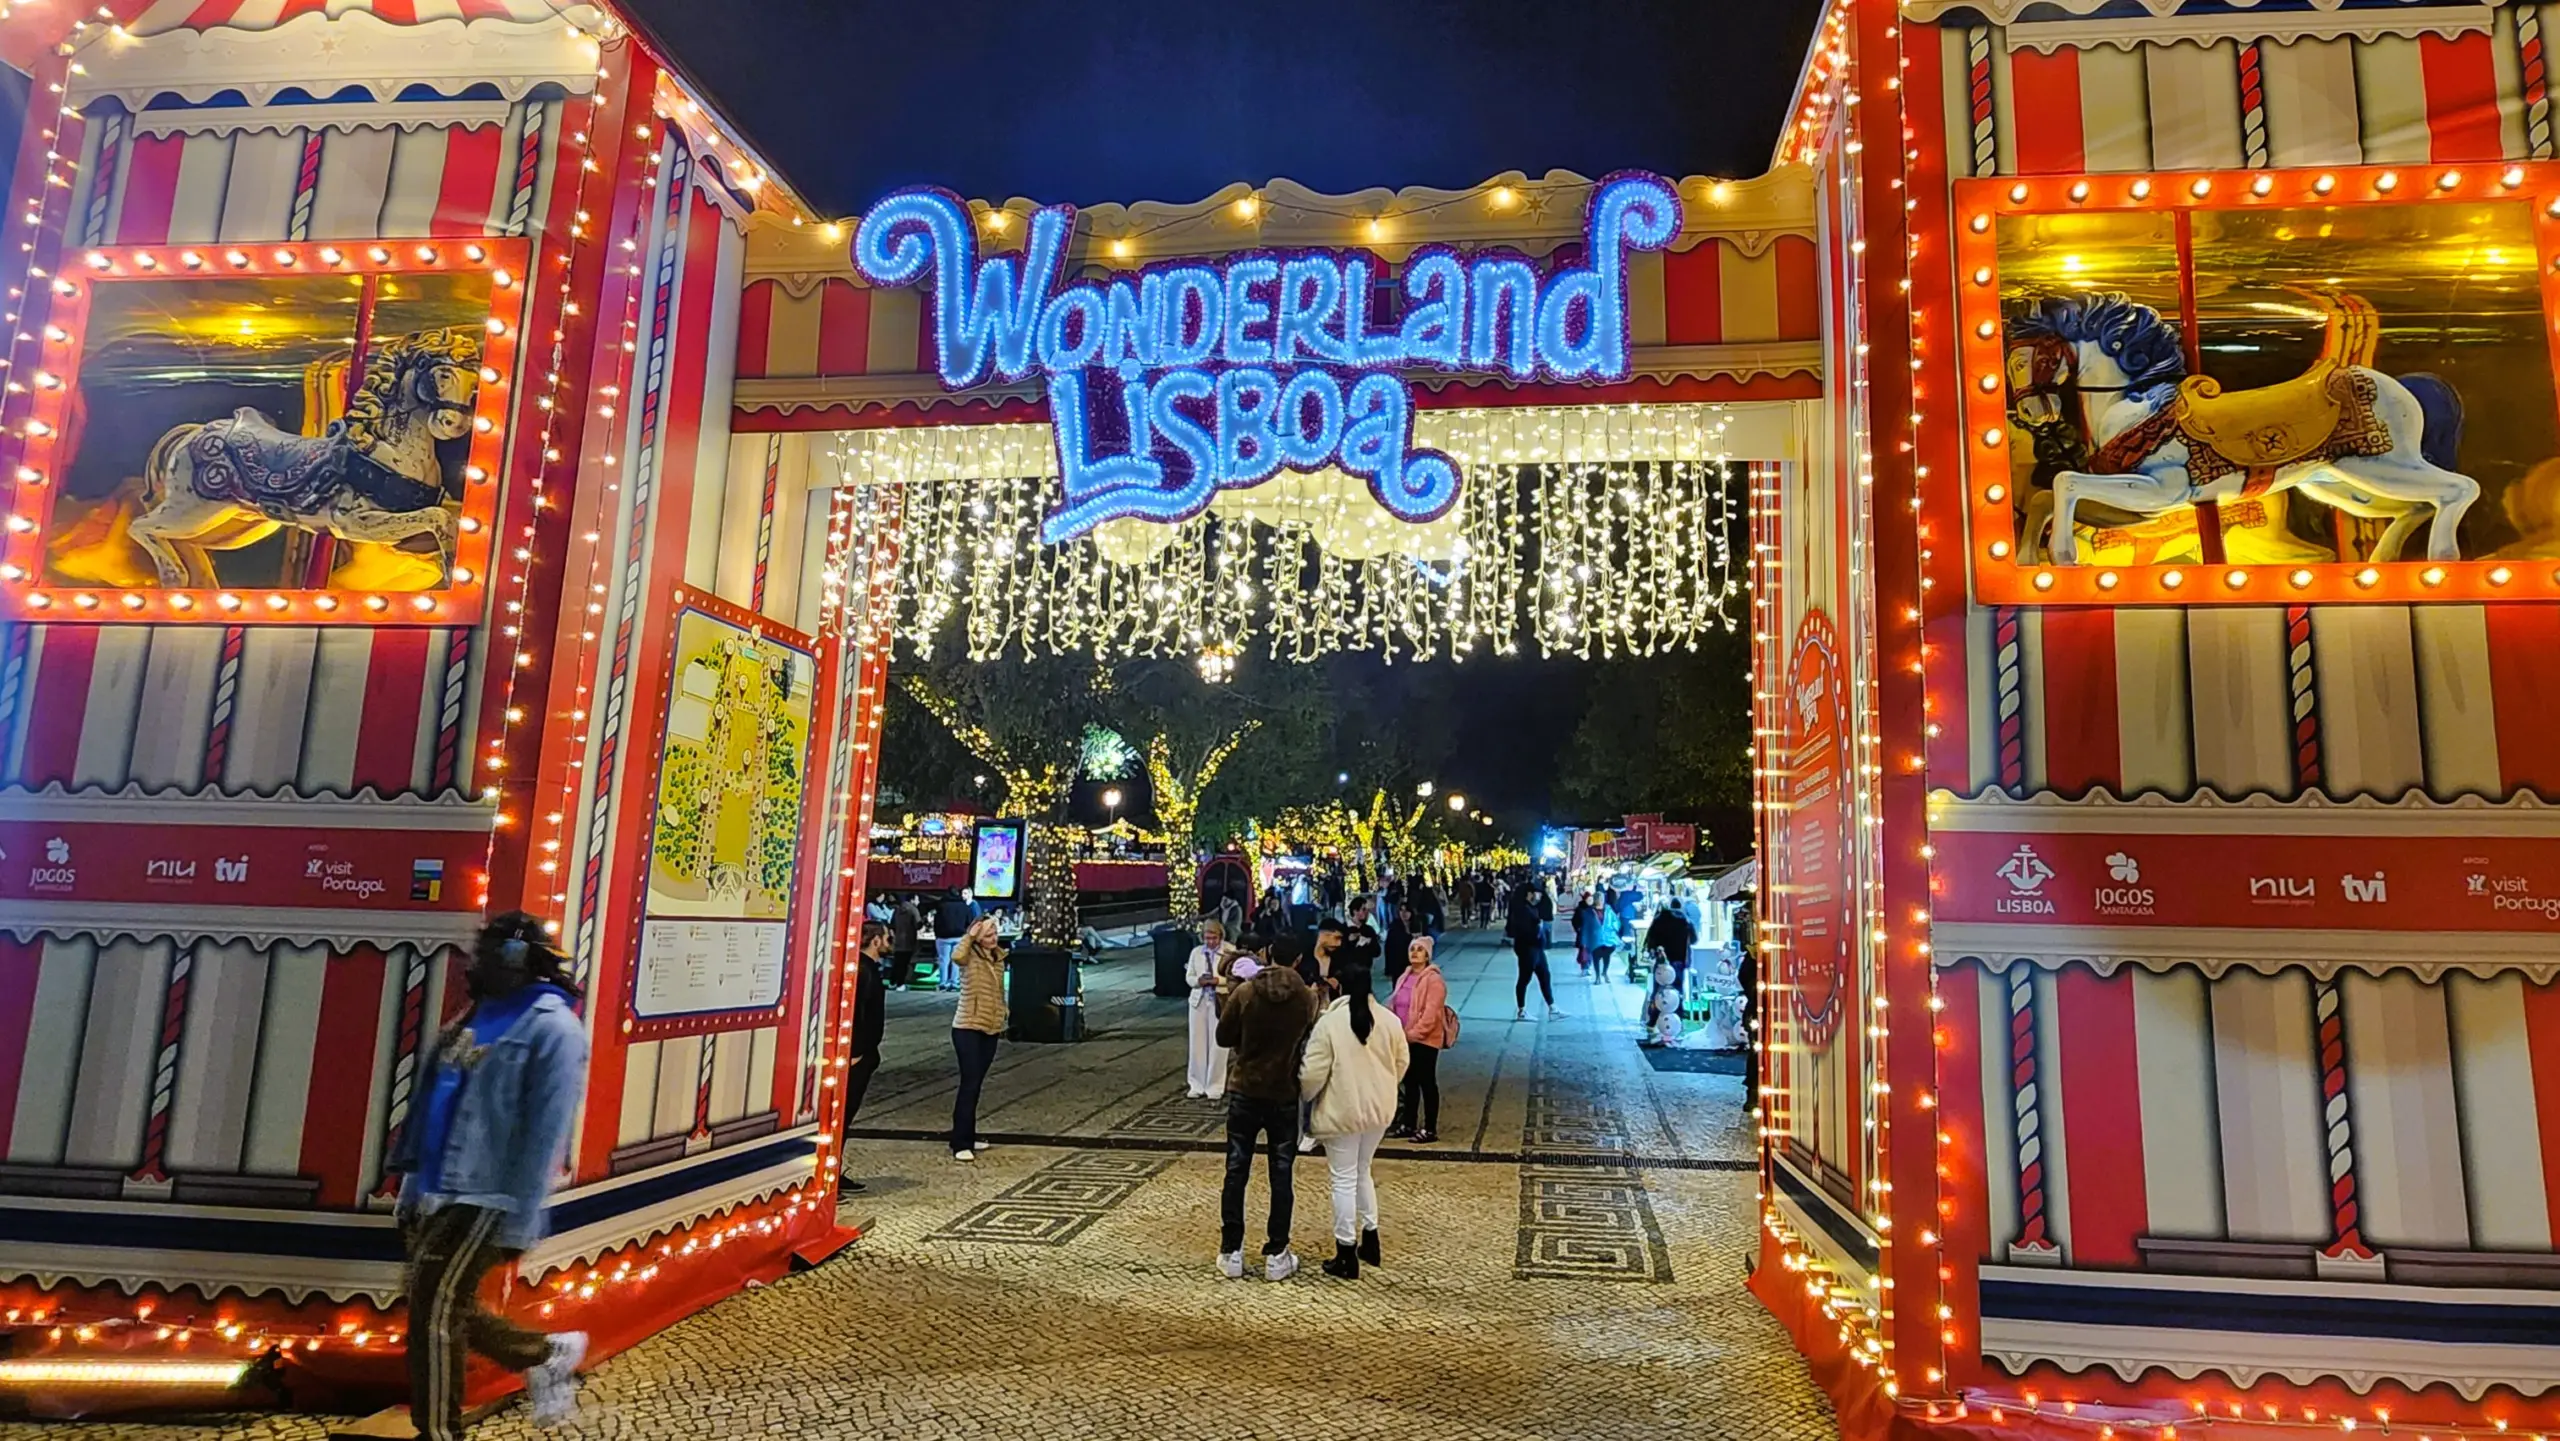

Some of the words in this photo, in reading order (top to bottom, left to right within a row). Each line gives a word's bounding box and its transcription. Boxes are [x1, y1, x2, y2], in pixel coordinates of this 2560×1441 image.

[29, 868, 76, 887] JOGOS
[215, 855, 249, 882] tvi
[325, 861, 354, 875] visit
[323, 877, 386, 899] Portugal
[2341, 871, 2387, 902] tvi
[2491, 875, 2530, 893] visit
[1996, 899, 2055, 914] LISBOA
[2094, 888, 2154, 910] JOGOS
[2494, 894, 2560, 920] Portug
